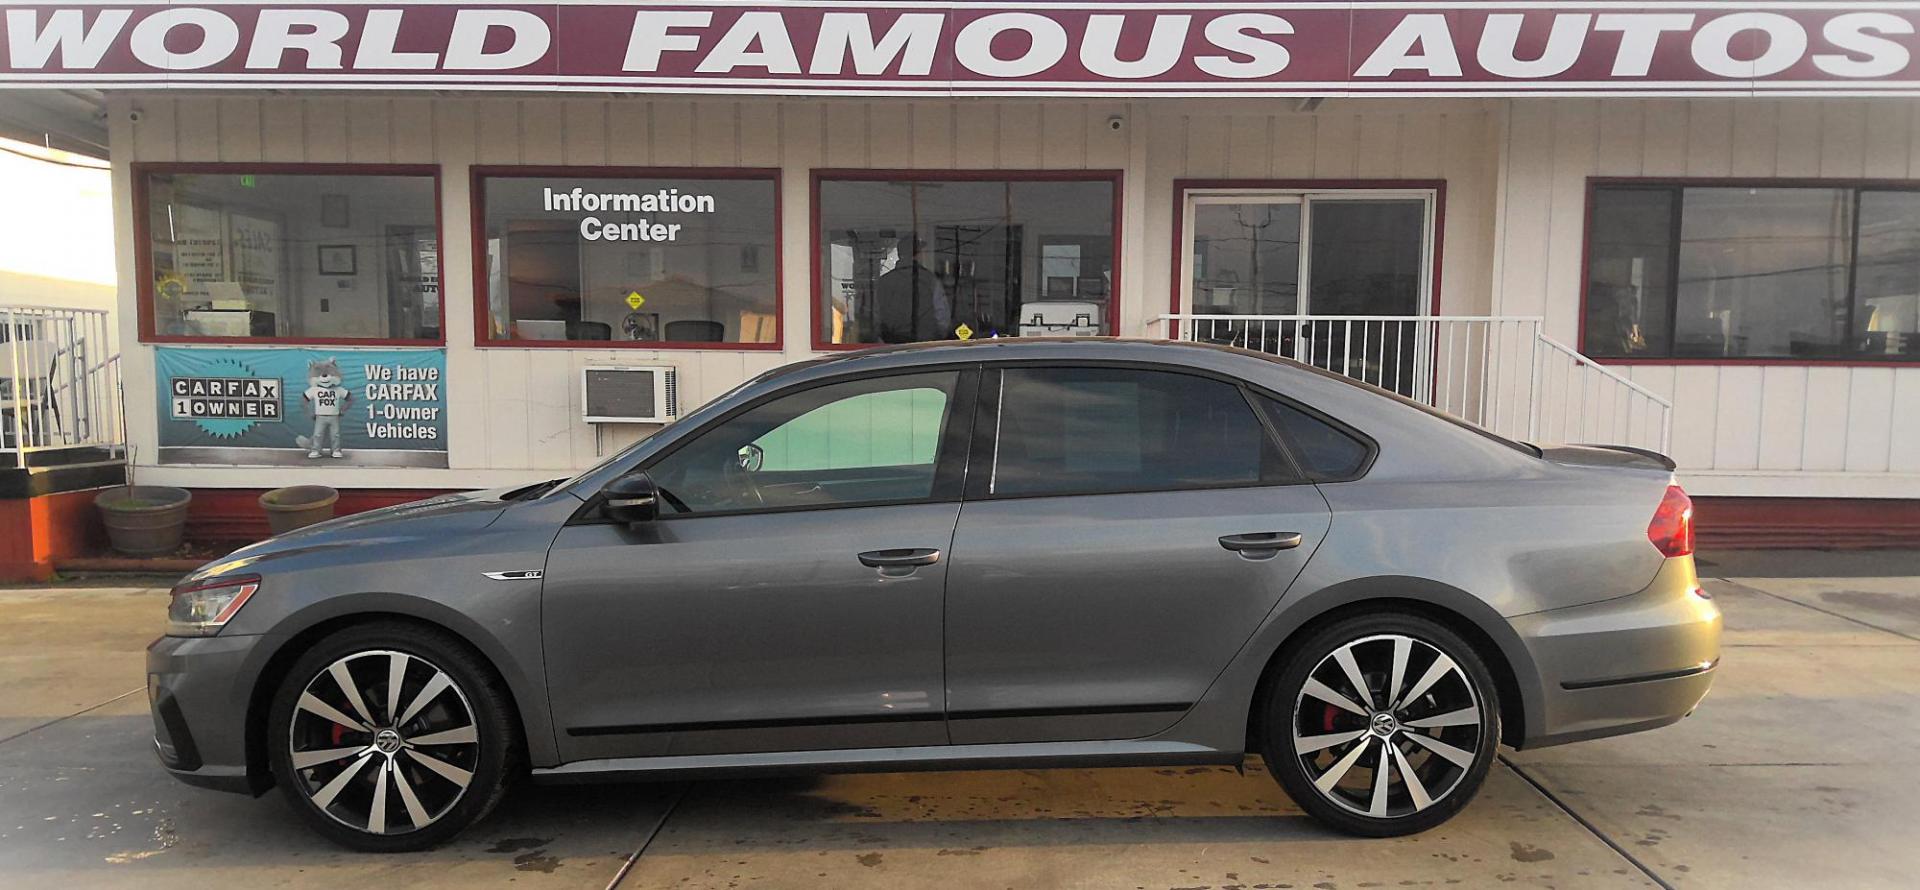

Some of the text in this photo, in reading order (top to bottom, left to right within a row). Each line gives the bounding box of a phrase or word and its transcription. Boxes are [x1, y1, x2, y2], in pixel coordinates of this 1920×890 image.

[6, 7, 1915, 79] WORLD FAMOUS AUTOS
[543, 187, 715, 213] Information
[580, 217, 681, 242] Center
[364, 364, 439, 381] We have
[174, 380, 277, 399] CARFAX
[365, 384, 438, 401] CARFAX
[193, 402, 277, 417] OWNER
[319, 399, 336, 407] FOX
[367, 403, 439, 421] 1-Owner
[367, 423, 438, 440] Vehicles
